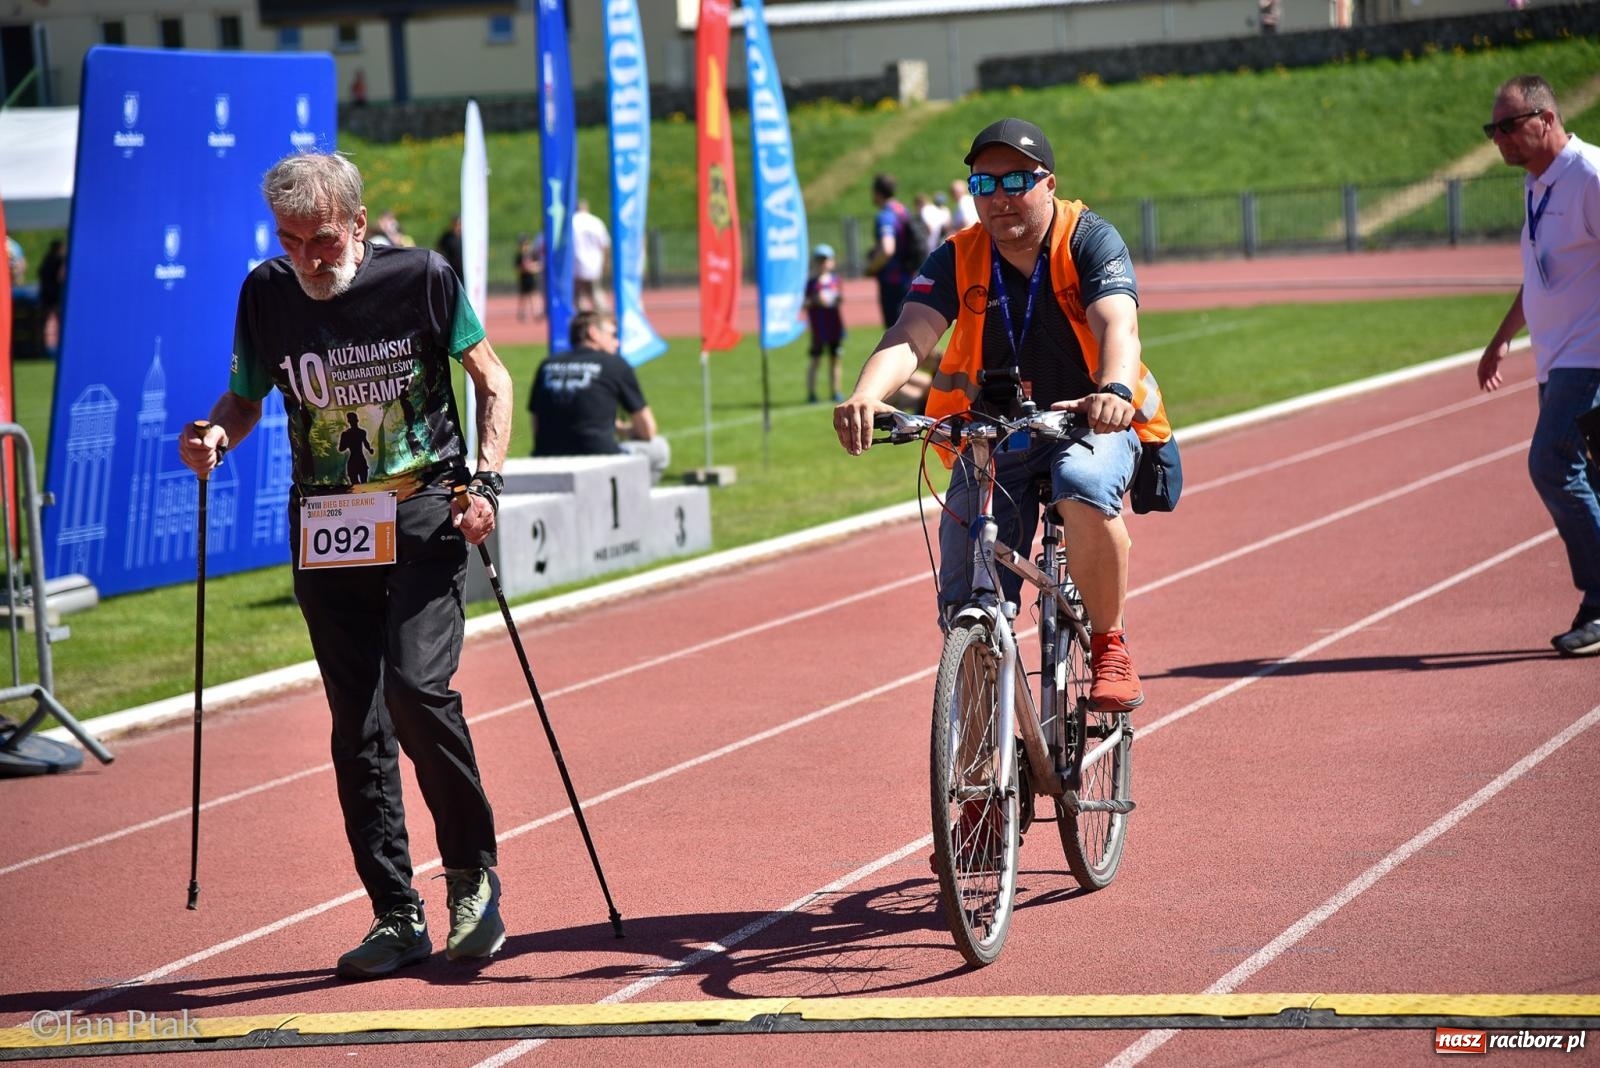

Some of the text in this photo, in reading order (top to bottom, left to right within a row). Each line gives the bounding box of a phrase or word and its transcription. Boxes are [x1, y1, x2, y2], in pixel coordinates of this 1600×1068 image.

[327, 338, 412, 367] KUŹNIAŃSKI
[331, 359, 414, 382] PÓŁMARATON LEŚNY
[279, 352, 330, 409] 10
[323, 500, 337, 508] BIEG
[339, 499, 349, 507] BEZ
[352, 498, 375, 506] GRANIC
[610, 476, 620, 530] 1
[313, 525, 370, 555] 092
[675, 505, 687, 547] 3
[532, 519, 548, 574] 2
